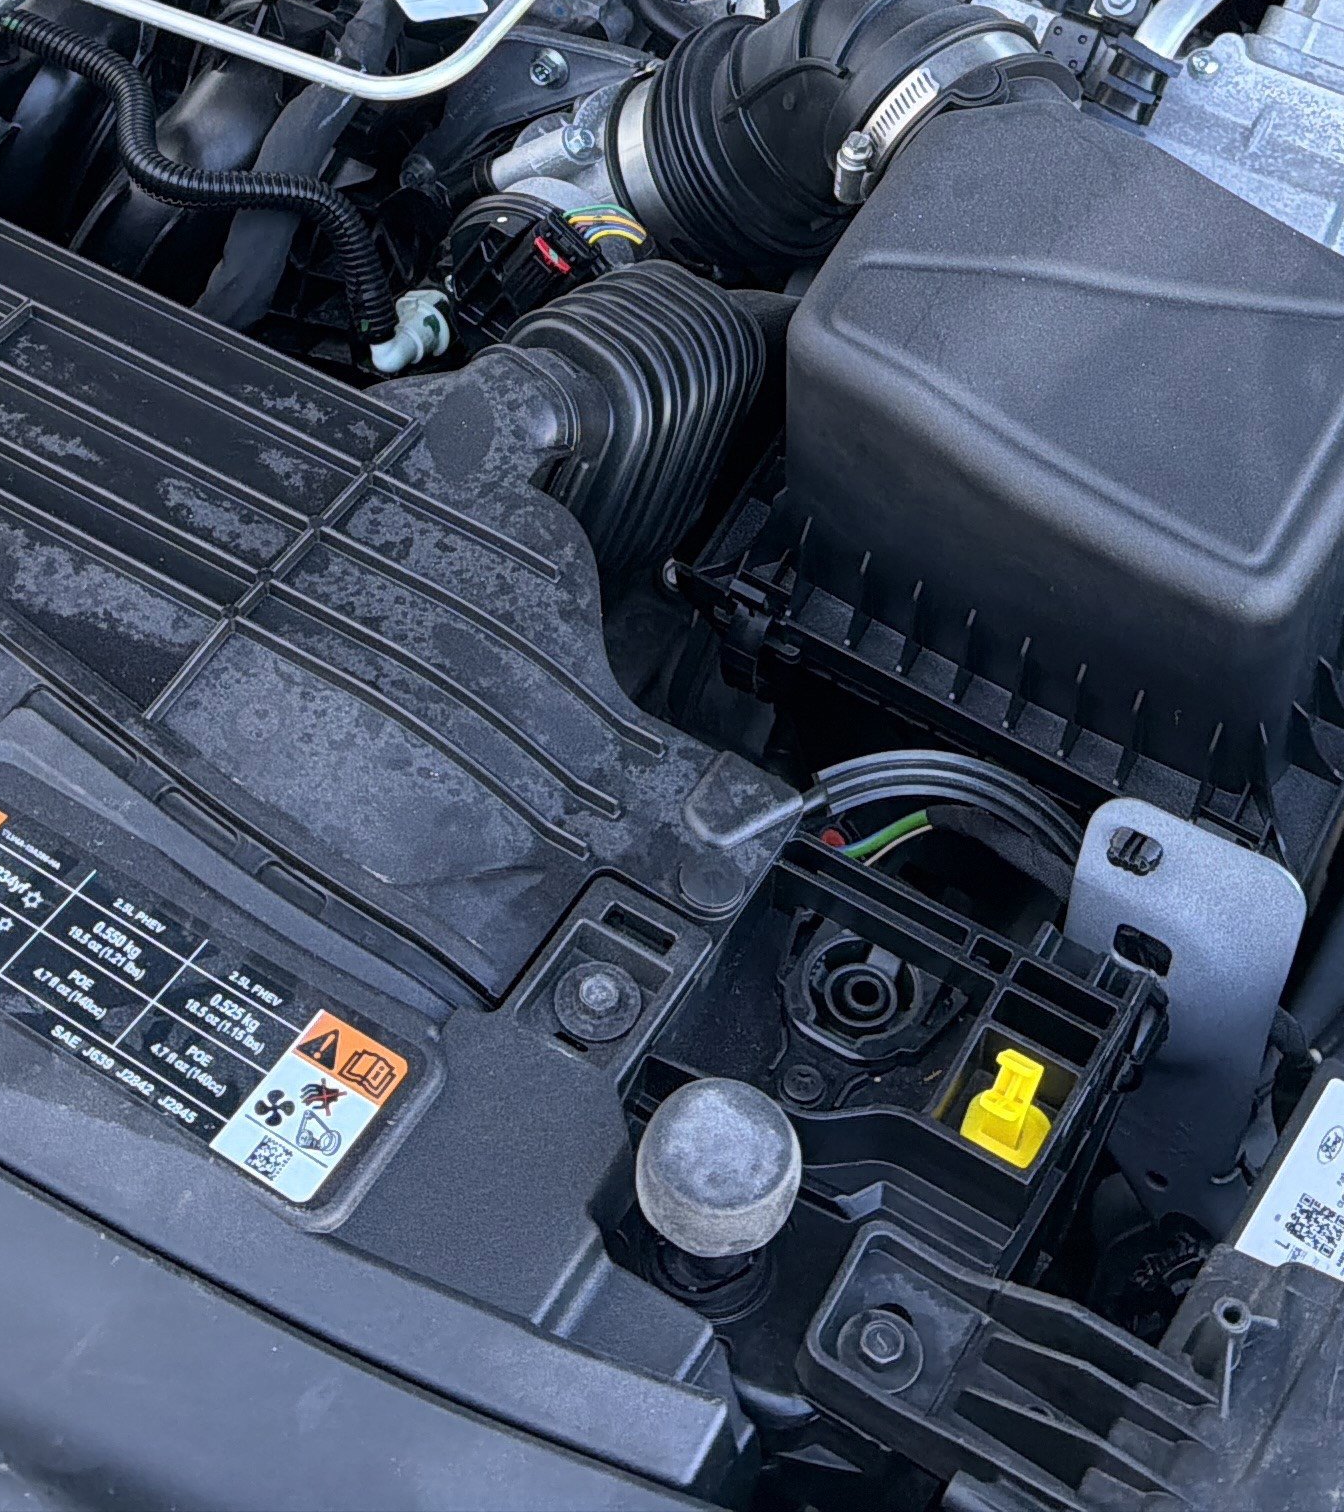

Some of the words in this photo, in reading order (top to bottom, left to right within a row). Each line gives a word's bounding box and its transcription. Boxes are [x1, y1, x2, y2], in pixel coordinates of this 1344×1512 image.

[112, 897, 132, 916] 2.5L
[134, 911, 166, 933] PHEV
[68, 925, 91, 944] 19.5
[87, 941, 102, 952] oz
[99, 946, 126, 966] (1.21
[123, 961, 144, 980] lbs)
[93, 921, 126, 947] 0.550
[123, 940, 141, 960] kg
[33, 968, 52, 982] 4.7
[55, 984, 72, 996] oz
[68, 990, 106, 1019] (140cc)
[67, 969, 94, 990] POE
[228, 970, 251, 989] 2.5L
[250, 984, 282, 1006] FHEV
[184, 997, 208, 1018] 18.5
[204, 1013, 219, 1026] oz
[218, 1020, 245, 1041] (1.15
[242, 1034, 264, 1054] lbs)
[210, 993, 245, 1020] 0.525
[241, 1013, 260, 1033] kg
[50, 1024, 82, 1048] SAE
[81, 1045, 115, 1070] J639
[115, 1066, 155, 1096] J2842
[157, 1094, 197, 1123] J2845
[150, 1043, 169, 1057] 4.7
[174, 1059, 190, 1072] oz
[187, 1067, 225, 1096] (140cc)
[185, 1045, 213, 1067] POE
